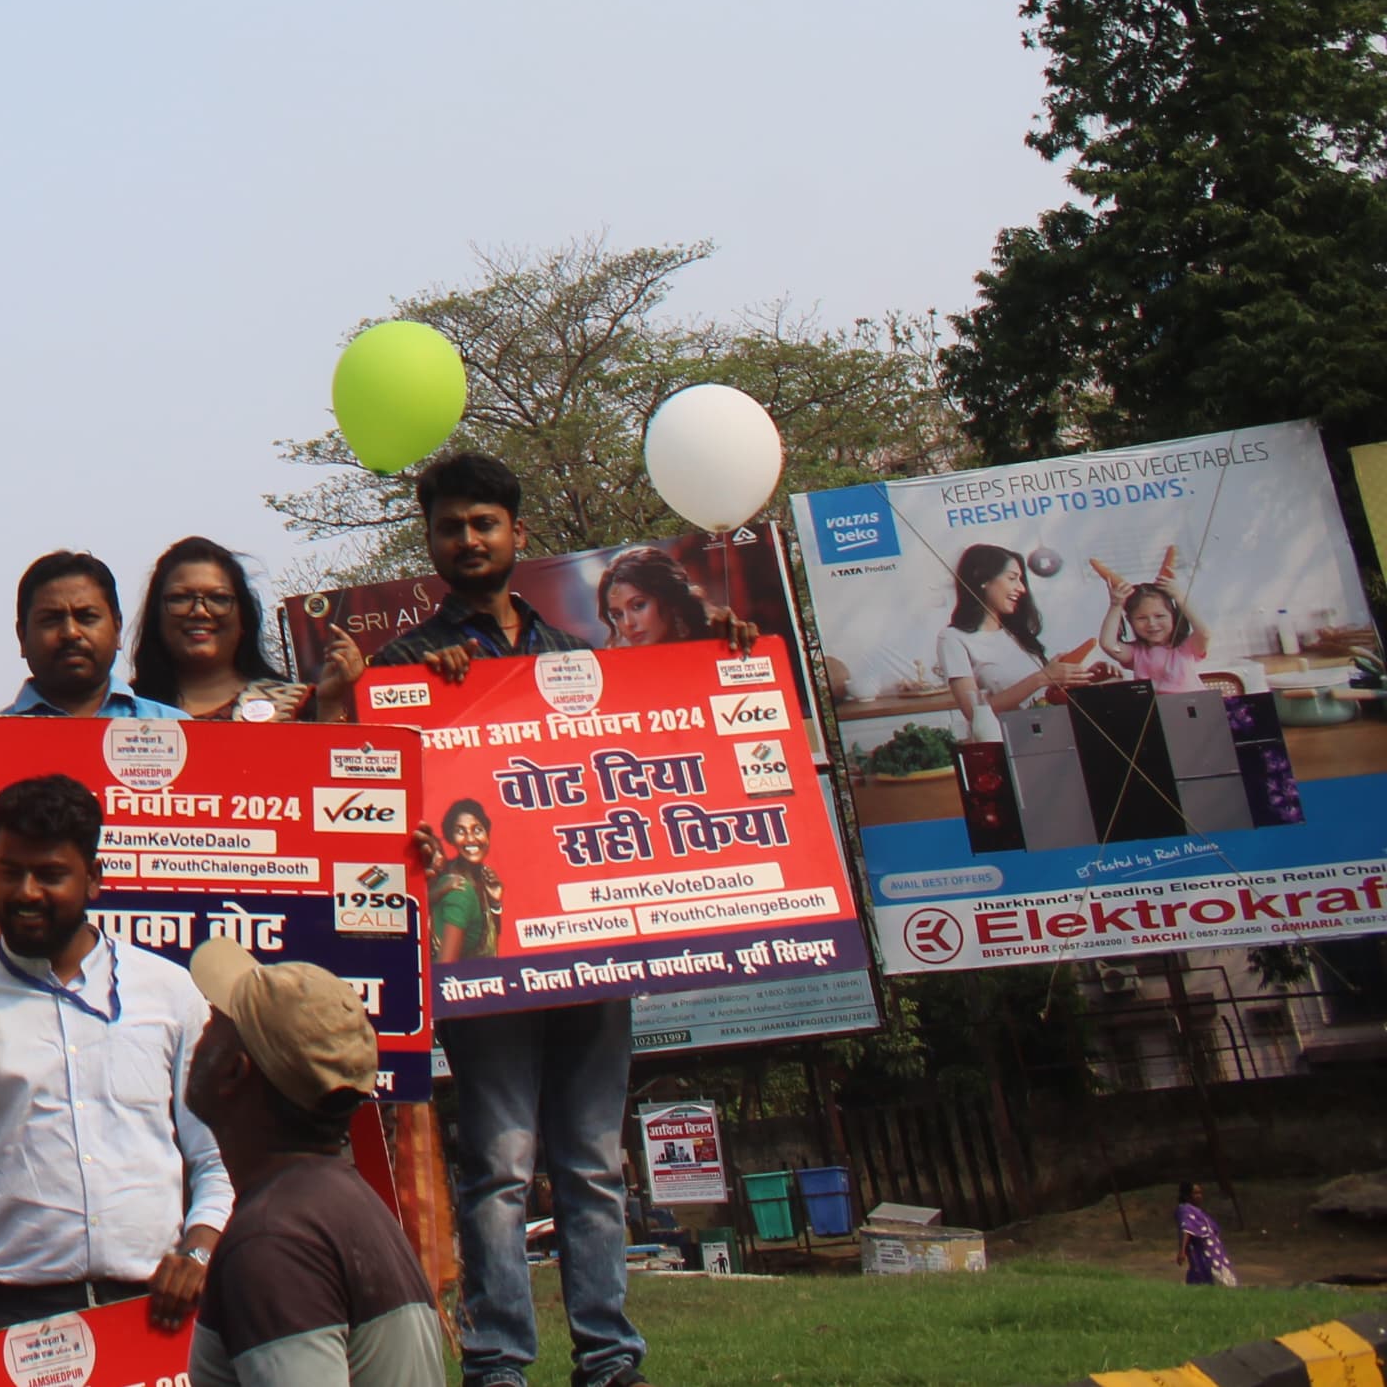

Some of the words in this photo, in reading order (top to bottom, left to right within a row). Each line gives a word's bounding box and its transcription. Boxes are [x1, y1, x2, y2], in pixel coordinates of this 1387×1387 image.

[940, 479, 1005, 503] KEEPS
[1008, 468, 1083, 496] FRUITS
[1087, 461, 1133, 485] AND
[1135, 443, 1269, 480] VEGETABLES
[826, 512, 880, 529] VOLTAS
[946, 498, 1019, 527] FRESH
[1023, 494, 1054, 518] UP
[1058, 491, 1089, 513] TO
[1092, 486, 1122, 509] 30
[833, 528, 878, 543] beko
[830, 570, 837, 578] A
[837, 567, 864, 577] TATA
[864, 563, 897, 574] Product
[347, 612, 389, 634] SRI
[373, 688, 428, 708] SWEEP
[721, 695, 778, 726] Vote
[487, 720, 541, 746] आम
[548, 708, 642, 740] निर्वाचन
[650, 707, 705, 733] 2024
[493, 756, 584, 811] वोट
[590, 748, 707, 803] दिया
[741, 762, 787, 776] 1950
[747, 777, 789, 790] CALL
[106, 785, 221, 821] निर्वाचन
[231, 796, 302, 822] 2024
[324, 789, 396, 826] Vote
[104, 831, 251, 849] #JamKeVoteDaalo
[553, 808, 651, 866] सही
[661, 801, 791, 857] किया
[151, 858, 310, 878] #YouthChalengeBooth
[1095, 853, 1132, 873] Tested
[1135, 854, 1152, 868] by
[1154, 845, 1180, 861] Real
[1184, 841, 1219, 855] Moms
[589, 871, 754, 902] #JamKeVoteDaalo
[890, 878, 921, 891] AVAIL
[923, 876, 949, 888] BEST
[951, 872, 994, 886] OFFERS
[973, 893, 1084, 912] Jharkhand's
[1090, 884, 1165, 900] Leading
[1170, 875, 1277, 893] Electronics
[1283, 868, 1337, 883] Retail
[336, 892, 406, 911] 1950
[523, 915, 629, 939] #MyFirstVote
[650, 893, 826, 925] #YouthChalengeBooth
[974, 876, 1387, 945] Elektrokraf
[208, 902, 286, 951] वोट
[342, 911, 401, 928] CALL
[982, 945, 1049, 959] BISTUPUR
[1059, 938, 1123, 952] 0657-2249200
[1131, 932, 1187, 945] SAKCHI
[1197, 926, 1263, 938] 0657-2222450
[1271, 918, 1344, 933] GAMHARIA
[440, 969, 503, 1002] सौजन्य
[522, 969, 573, 993] जिला
[577, 957, 643, 988] निर्वाचन
[647, 949, 733, 978] कार्यालय,
[735, 939, 771, 974] पूर्वी
[771, 939, 836, 966] सिंहभूम
